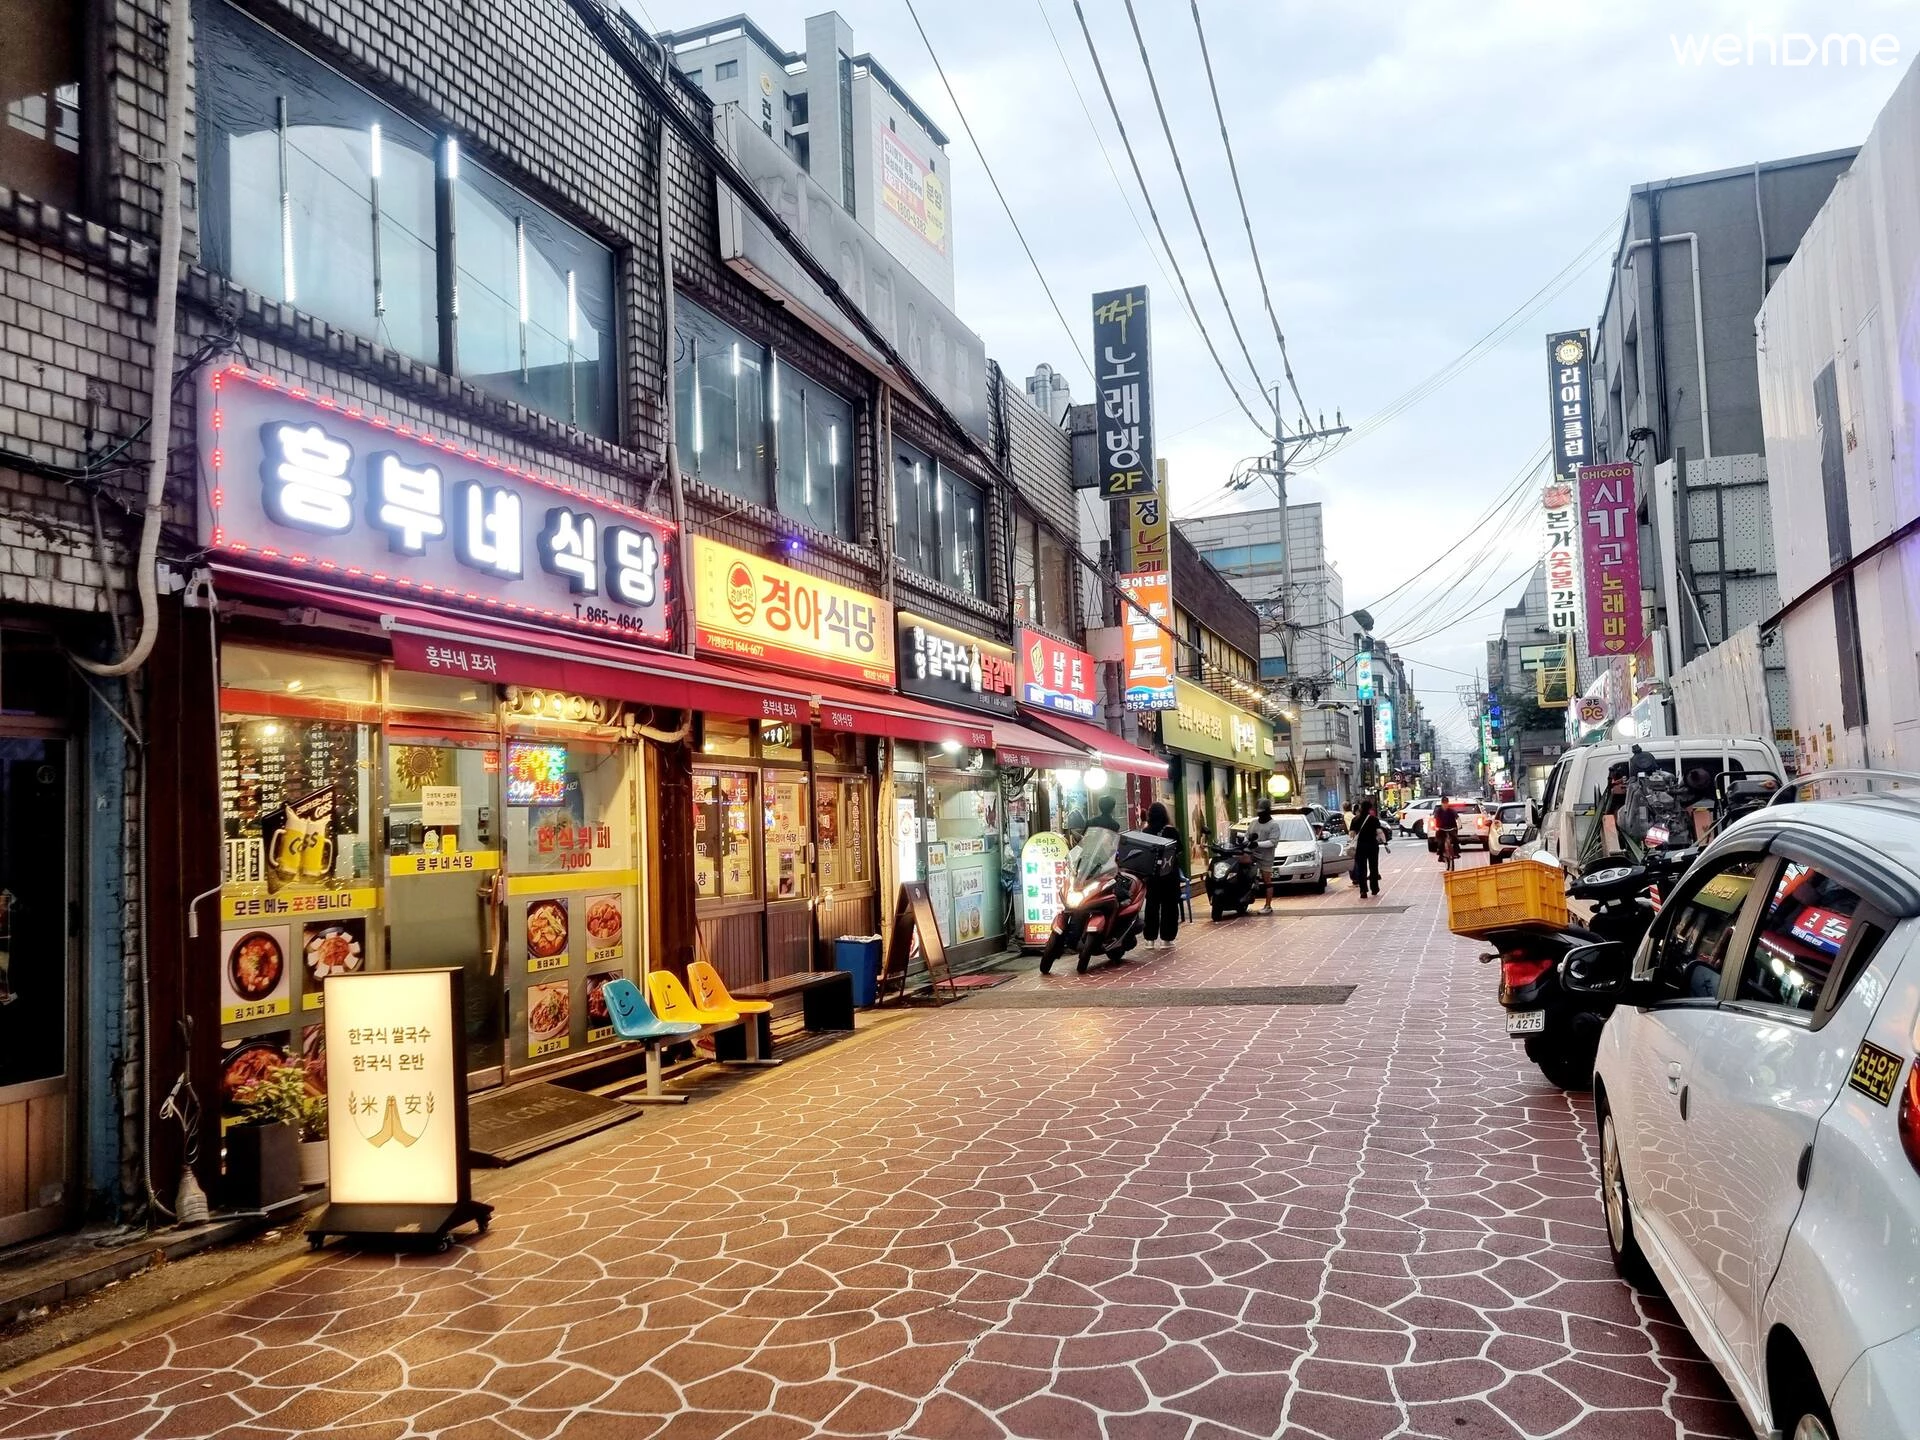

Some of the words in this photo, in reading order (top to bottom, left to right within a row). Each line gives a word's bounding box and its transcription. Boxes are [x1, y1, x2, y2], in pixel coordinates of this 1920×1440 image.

[1102, 346, 1144, 469] 노래방
[1560, 366, 1584, 457] 라이브클럽
[1109, 470, 1143, 493] 2F
[1588, 480, 1630, 566] 시카고
[761, 574, 877, 653] 경아식당
[425, 645, 467, 671] 흥부네
[469, 652, 498, 676] 포차
[926, 634, 970, 685] 칼국수
[762, 700, 784, 717] 흥부네
[784, 703, 798, 718] 포차
[1581, 706, 1604, 722] PC
[416, 855, 474, 871] 흥부네식당
[560, 852, 592, 870] 7,000
[234, 901, 261, 916] 모든
[264, 899, 289, 913] 메뉴
[292, 894, 353, 912] 포장됩니다
[234, 1003, 276, 1019] 김치찌개
[1516, 1018, 1541, 1030] 4275
[348, 1027, 388, 1045] 한국식
[391, 1026, 432, 1045] 쌀국수
[352, 1054, 392, 1073] 한국식
[398, 1054, 425, 1072] 온반
[1852, 1047, 1899, 1099] 초보운전
[361, 1094, 379, 1115] 米
[404, 1095, 423, 1115] 安
